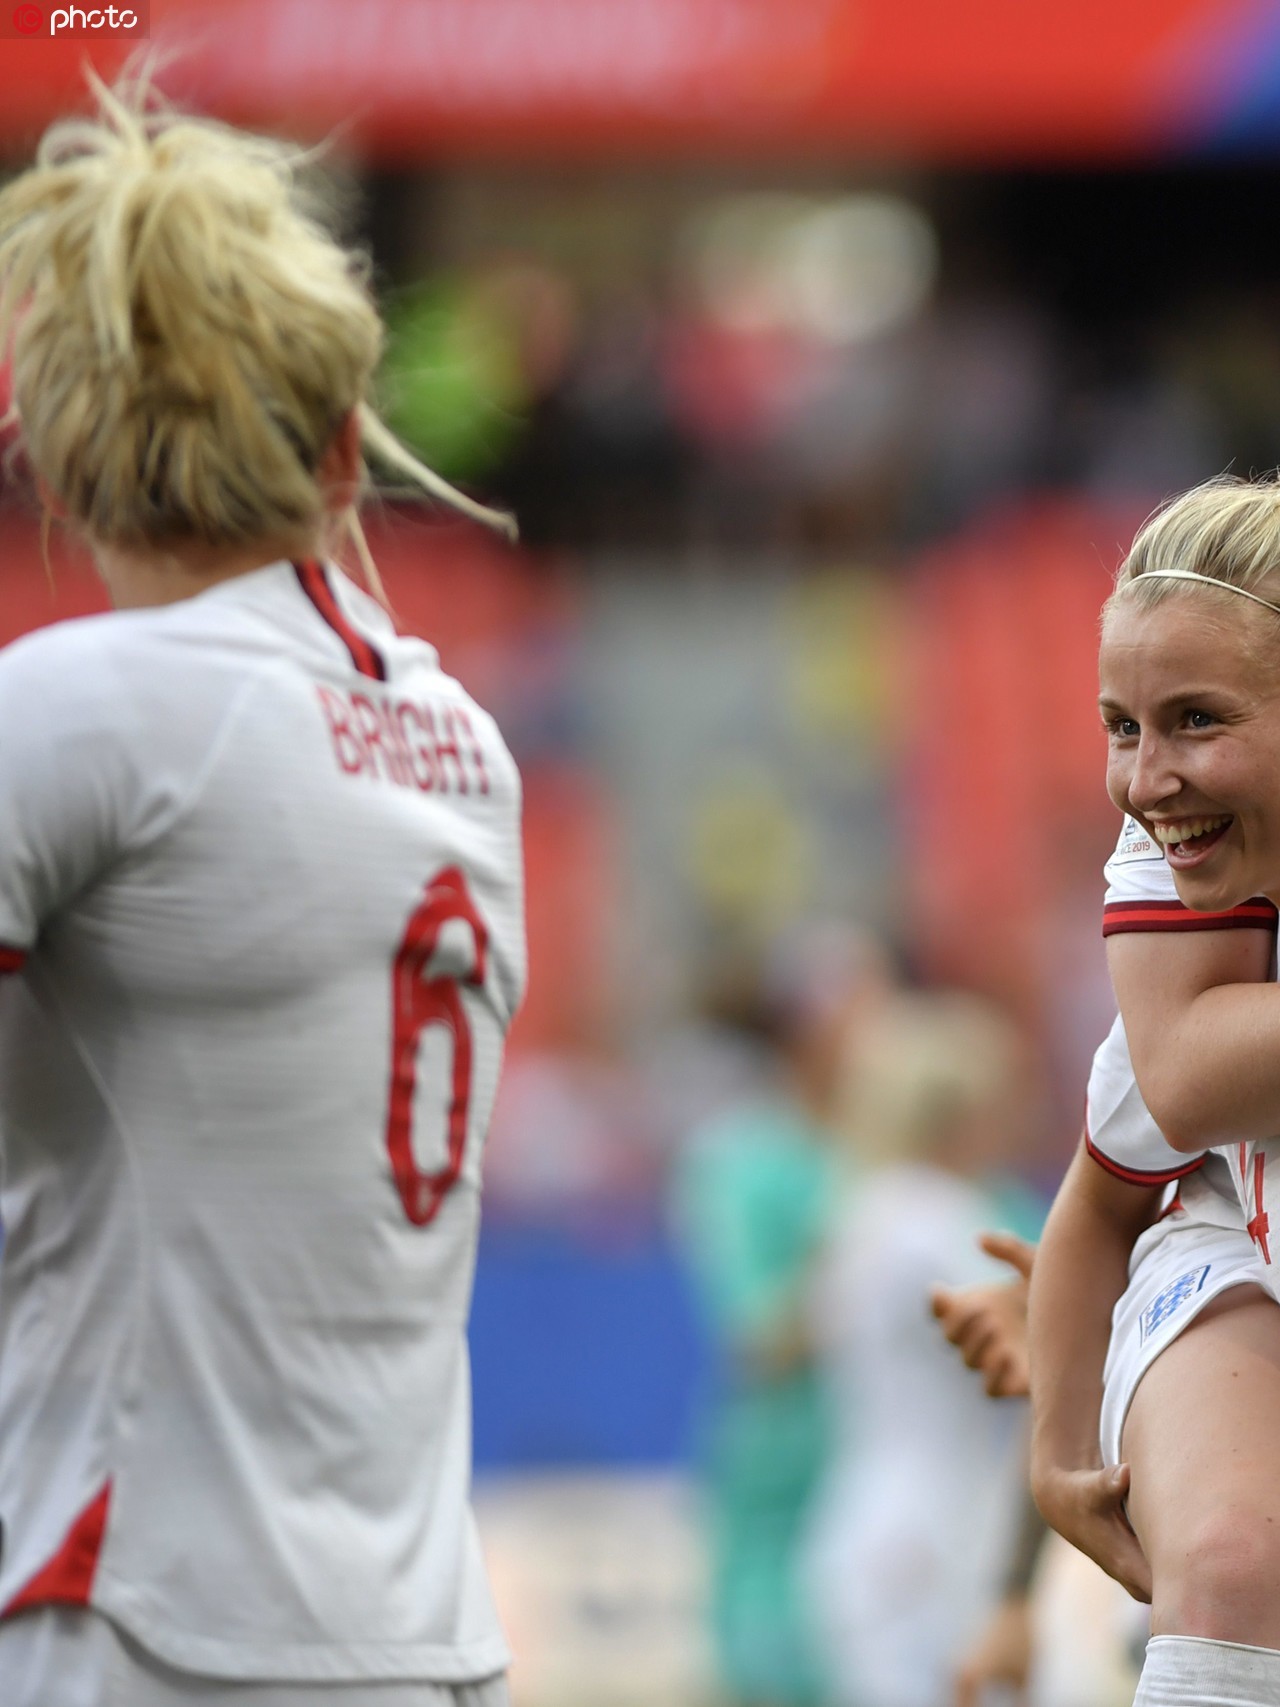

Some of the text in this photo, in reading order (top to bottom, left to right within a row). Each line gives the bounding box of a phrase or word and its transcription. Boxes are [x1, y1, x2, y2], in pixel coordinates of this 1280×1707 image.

[315, 683, 489, 795] BRIGHT
[1132, 840, 1151, 853] 2019
[385, 865, 488, 1229] 6
